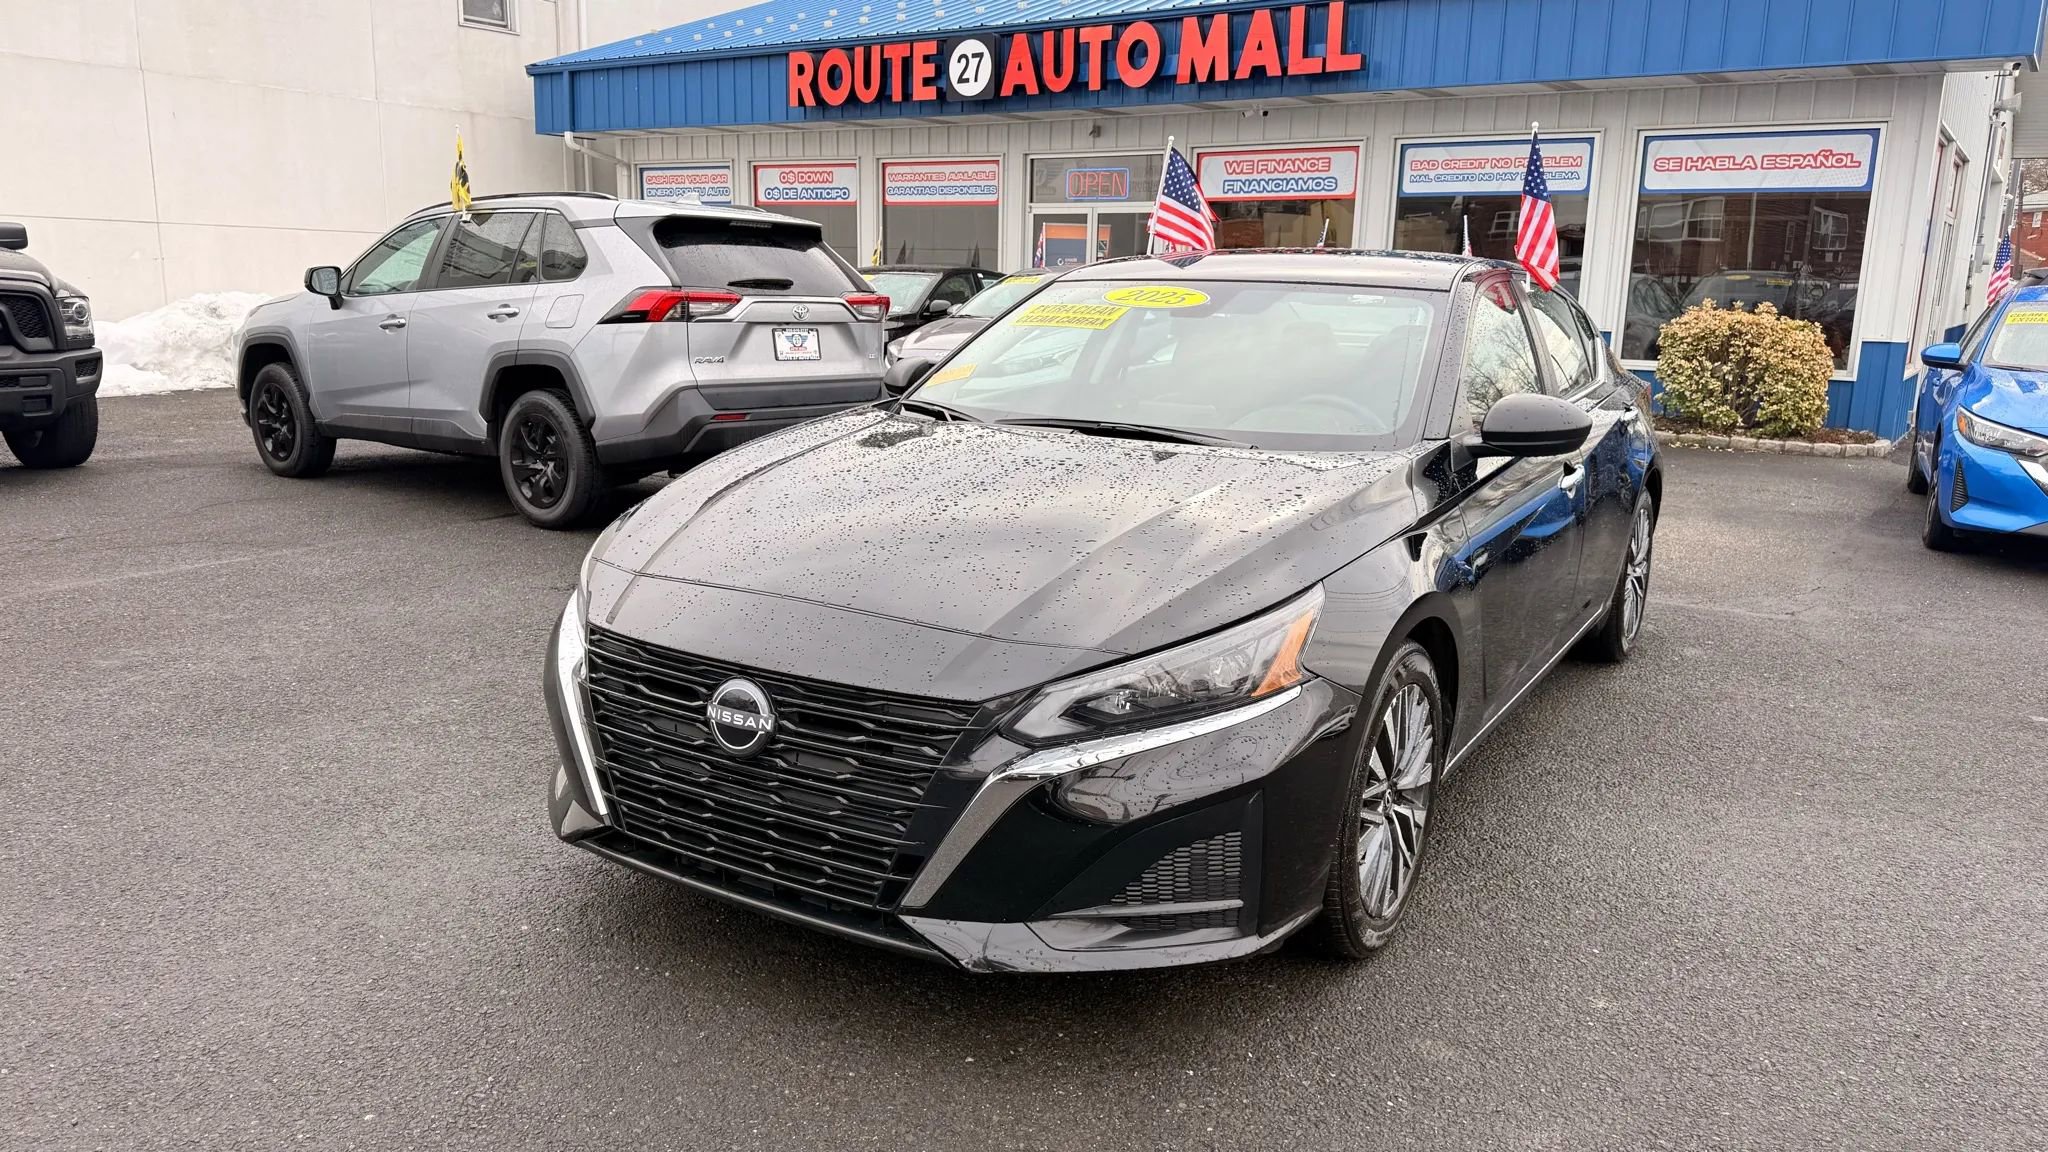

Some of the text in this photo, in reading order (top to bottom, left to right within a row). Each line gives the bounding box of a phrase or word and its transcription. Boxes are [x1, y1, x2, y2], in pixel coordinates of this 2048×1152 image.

[787, 1, 1363, 107] ROUTE 27 AUTO MALL
[1224, 157, 1331, 175] WE FINANCE
[1410, 156, 1583, 171] BAD CREDIT NO PBLEM
[1654, 149, 1861, 172] SE HABLA ESPAÑOL
[646, 174, 728, 184] CASH FOR YOUR CAR
[797, 170, 833, 183] DOWN
[888, 170, 997, 183] WARRANTIES AVAILABLE
[1410, 174, 1433, 183] MAL
[1434, 173, 1477, 182] CREDITO
[1478, 172, 1495, 182] NO
[1495, 172, 1520, 181] HAY
[887, 184, 997, 196] GARANTIAS DISPONIBLES
[1068, 171, 1127, 197] OPEN
[1223, 177, 1338, 194] FINANCIAMOS
[647, 188, 674, 197] DINERO
[707, 187, 730, 196] AUTO
[782, 187, 798, 200] DE
[799, 186, 850, 200] ANTICIPO
[1117, 289, 1197, 304] 2025
[1030, 304, 1122, 316] EXTRA CLEAN
[694, 355, 725, 364] RAV4
[707, 705, 772, 730] NISSAN
